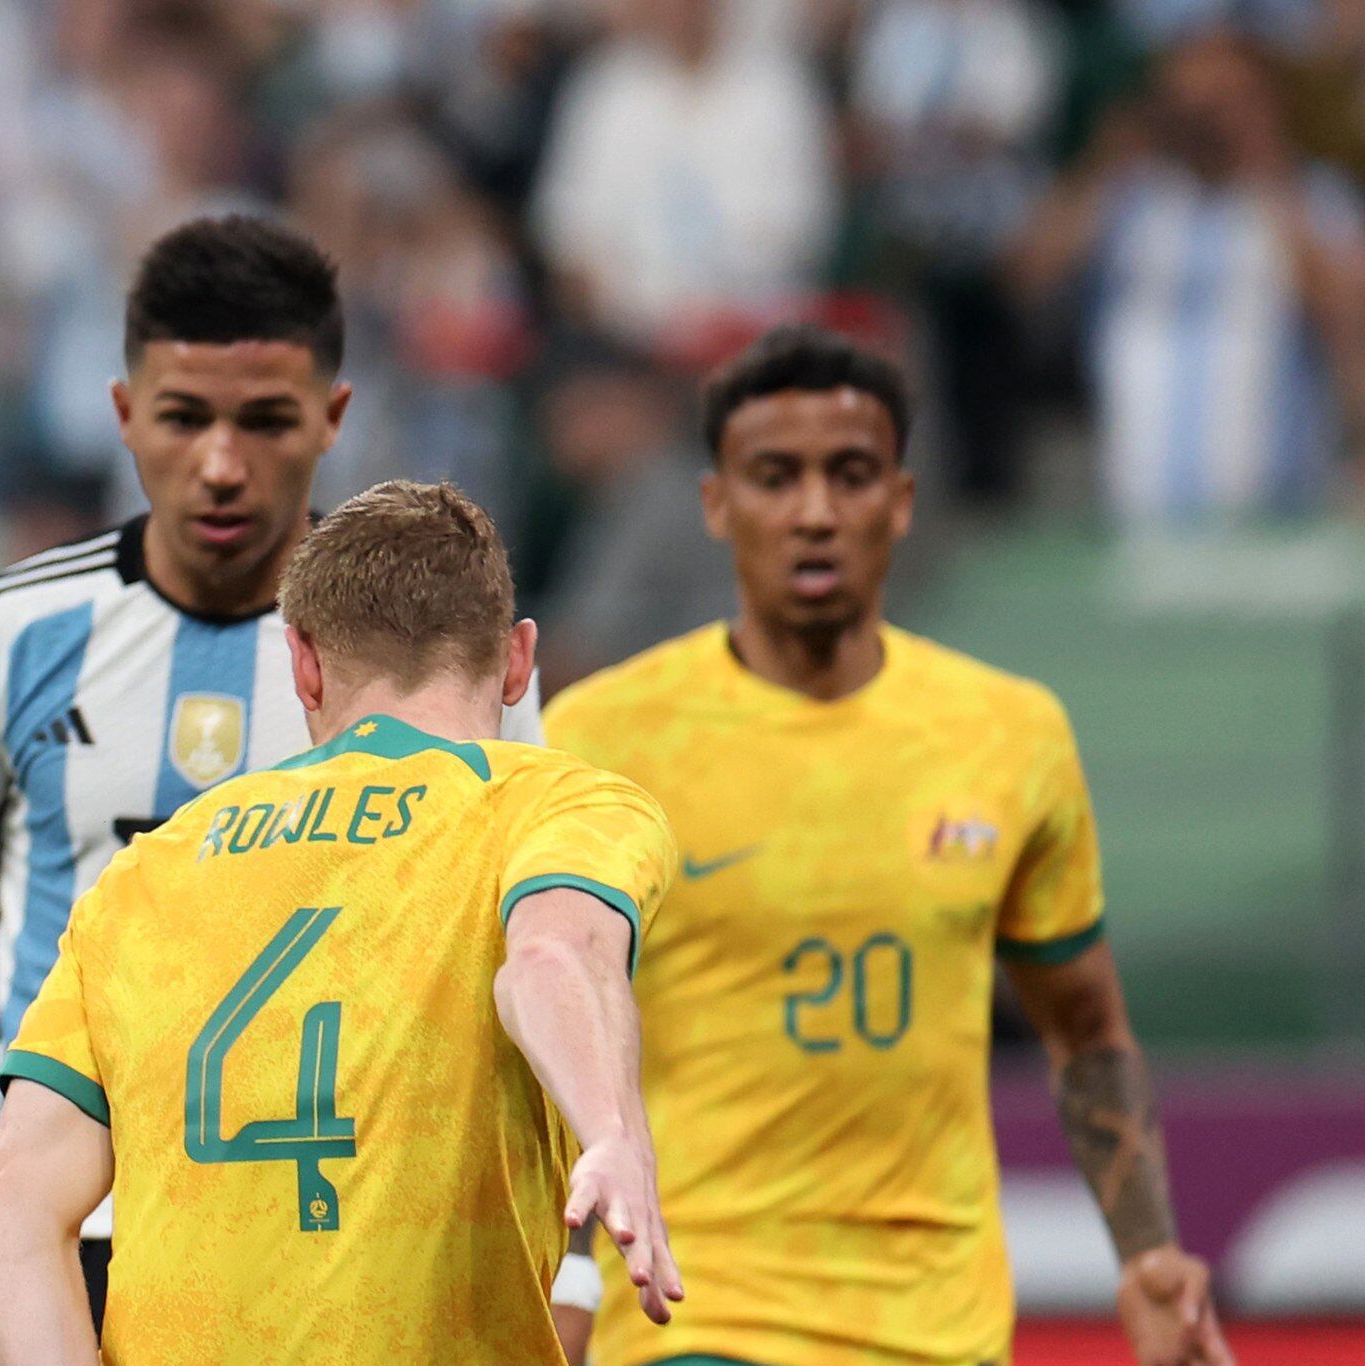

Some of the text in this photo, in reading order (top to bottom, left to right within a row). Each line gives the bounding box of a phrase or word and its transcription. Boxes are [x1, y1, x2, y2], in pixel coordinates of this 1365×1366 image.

[196, 785, 427, 863] ROWLES
[782, 932, 912, 1053] 20
[183, 906, 356, 1231] 4
